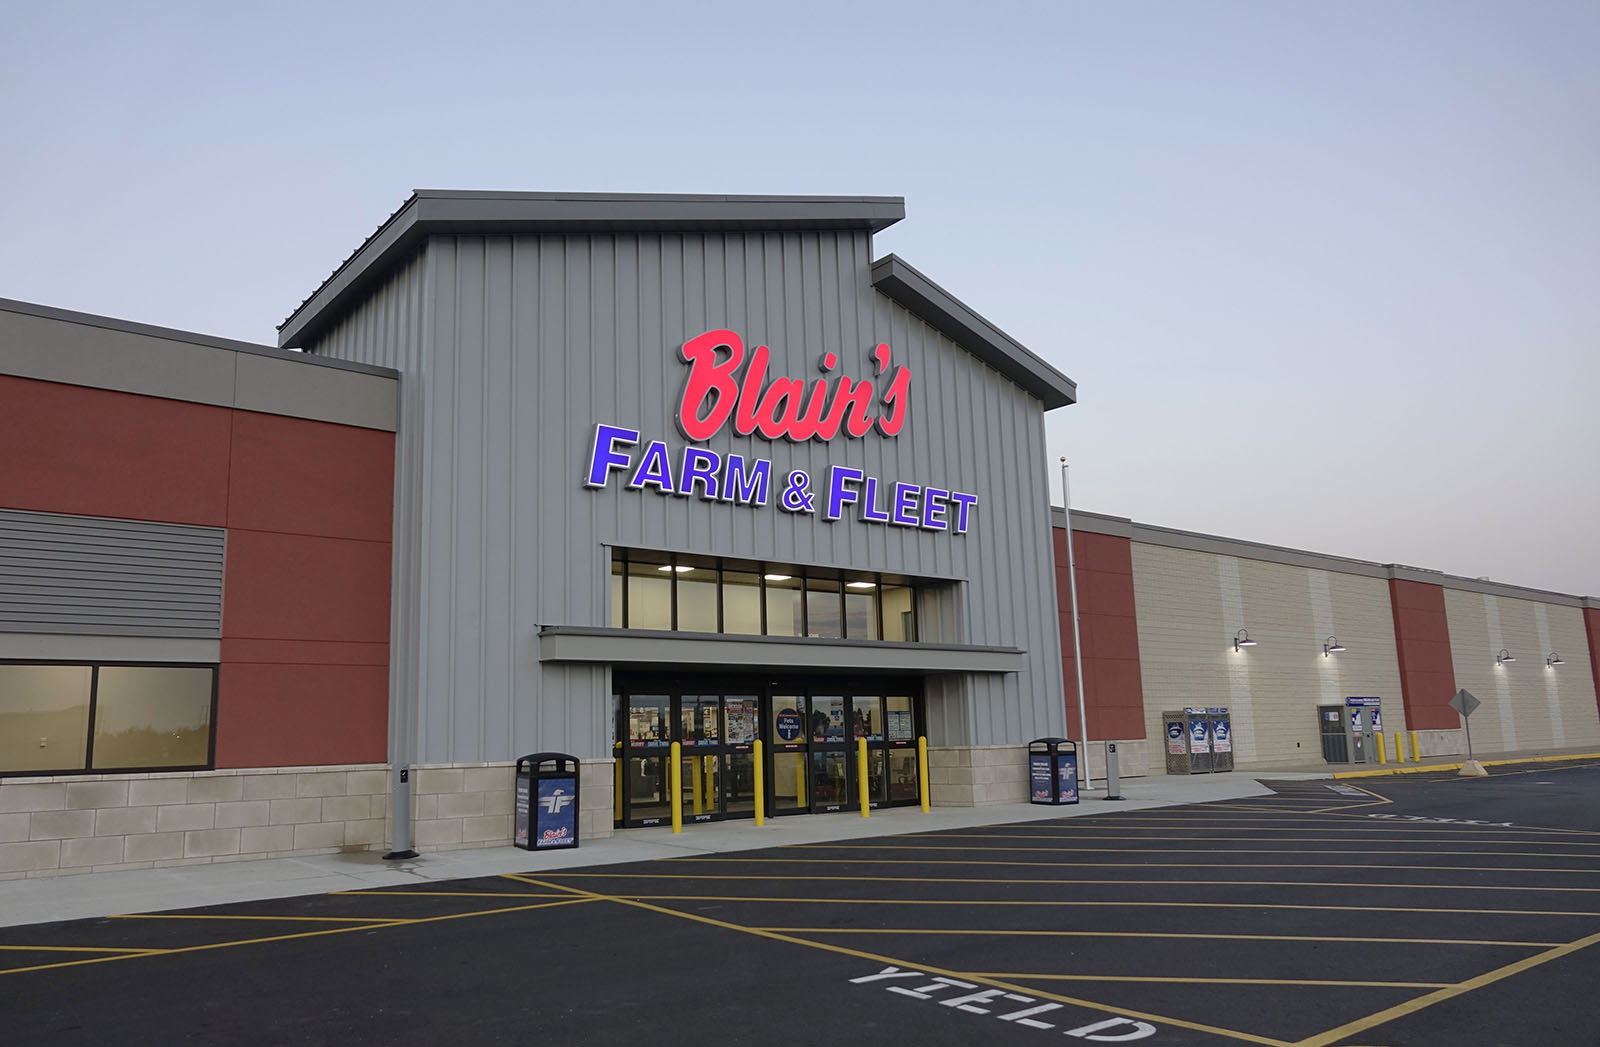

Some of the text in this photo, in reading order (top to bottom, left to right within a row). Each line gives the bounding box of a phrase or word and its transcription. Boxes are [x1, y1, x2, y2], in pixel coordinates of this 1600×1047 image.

[679, 329, 911, 442] Blain's
[781, 469, 815, 513] &
[849, 965, 1157, 1042] YIELD
